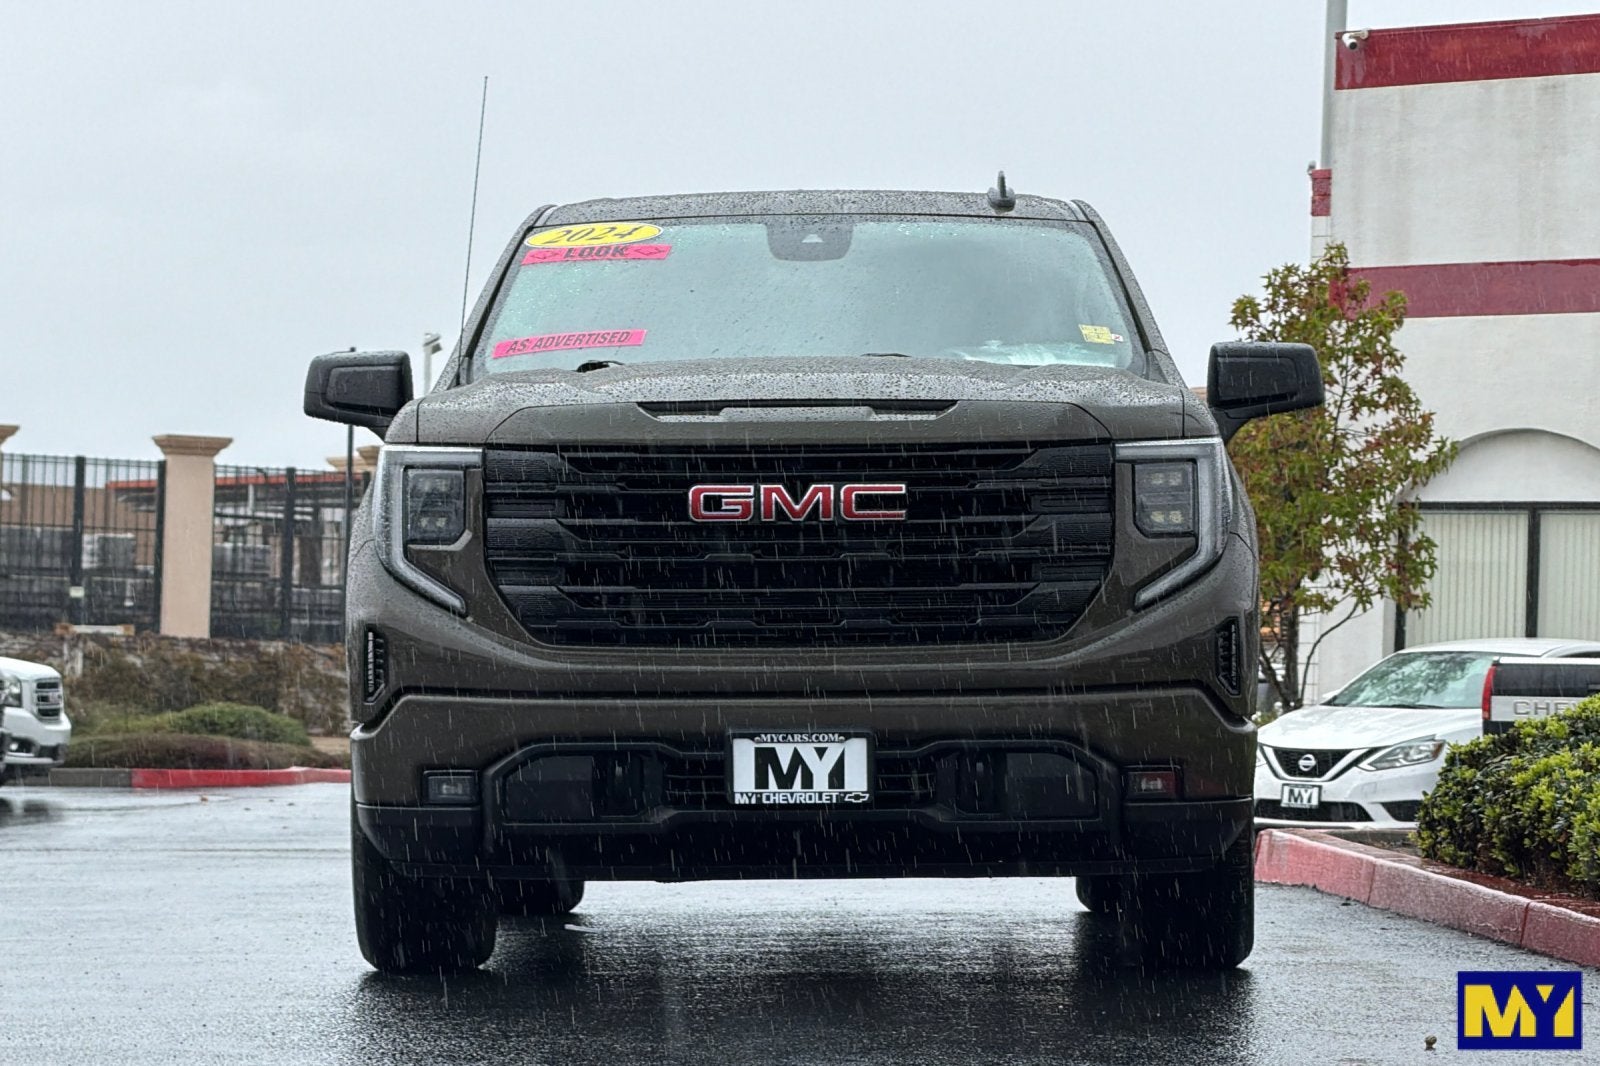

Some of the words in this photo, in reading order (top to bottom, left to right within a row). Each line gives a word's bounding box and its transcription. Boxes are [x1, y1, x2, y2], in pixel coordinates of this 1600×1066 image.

[543, 225, 645, 245] 2024
[563, 245, 631, 259] LOOK
[506, 340, 530, 354] AS
[532, 331, 632, 349] ADVERTISED
[688, 484, 907, 521] GMC
[1513, 701, 1577, 716] CHE
[760, 733, 839, 743] MYCARS.COM
[754, 746, 845, 790] MY
[734, 792, 756, 804] MY
[762, 792, 839, 804] CHEVROLET
[1288, 788, 1313, 804] MY
